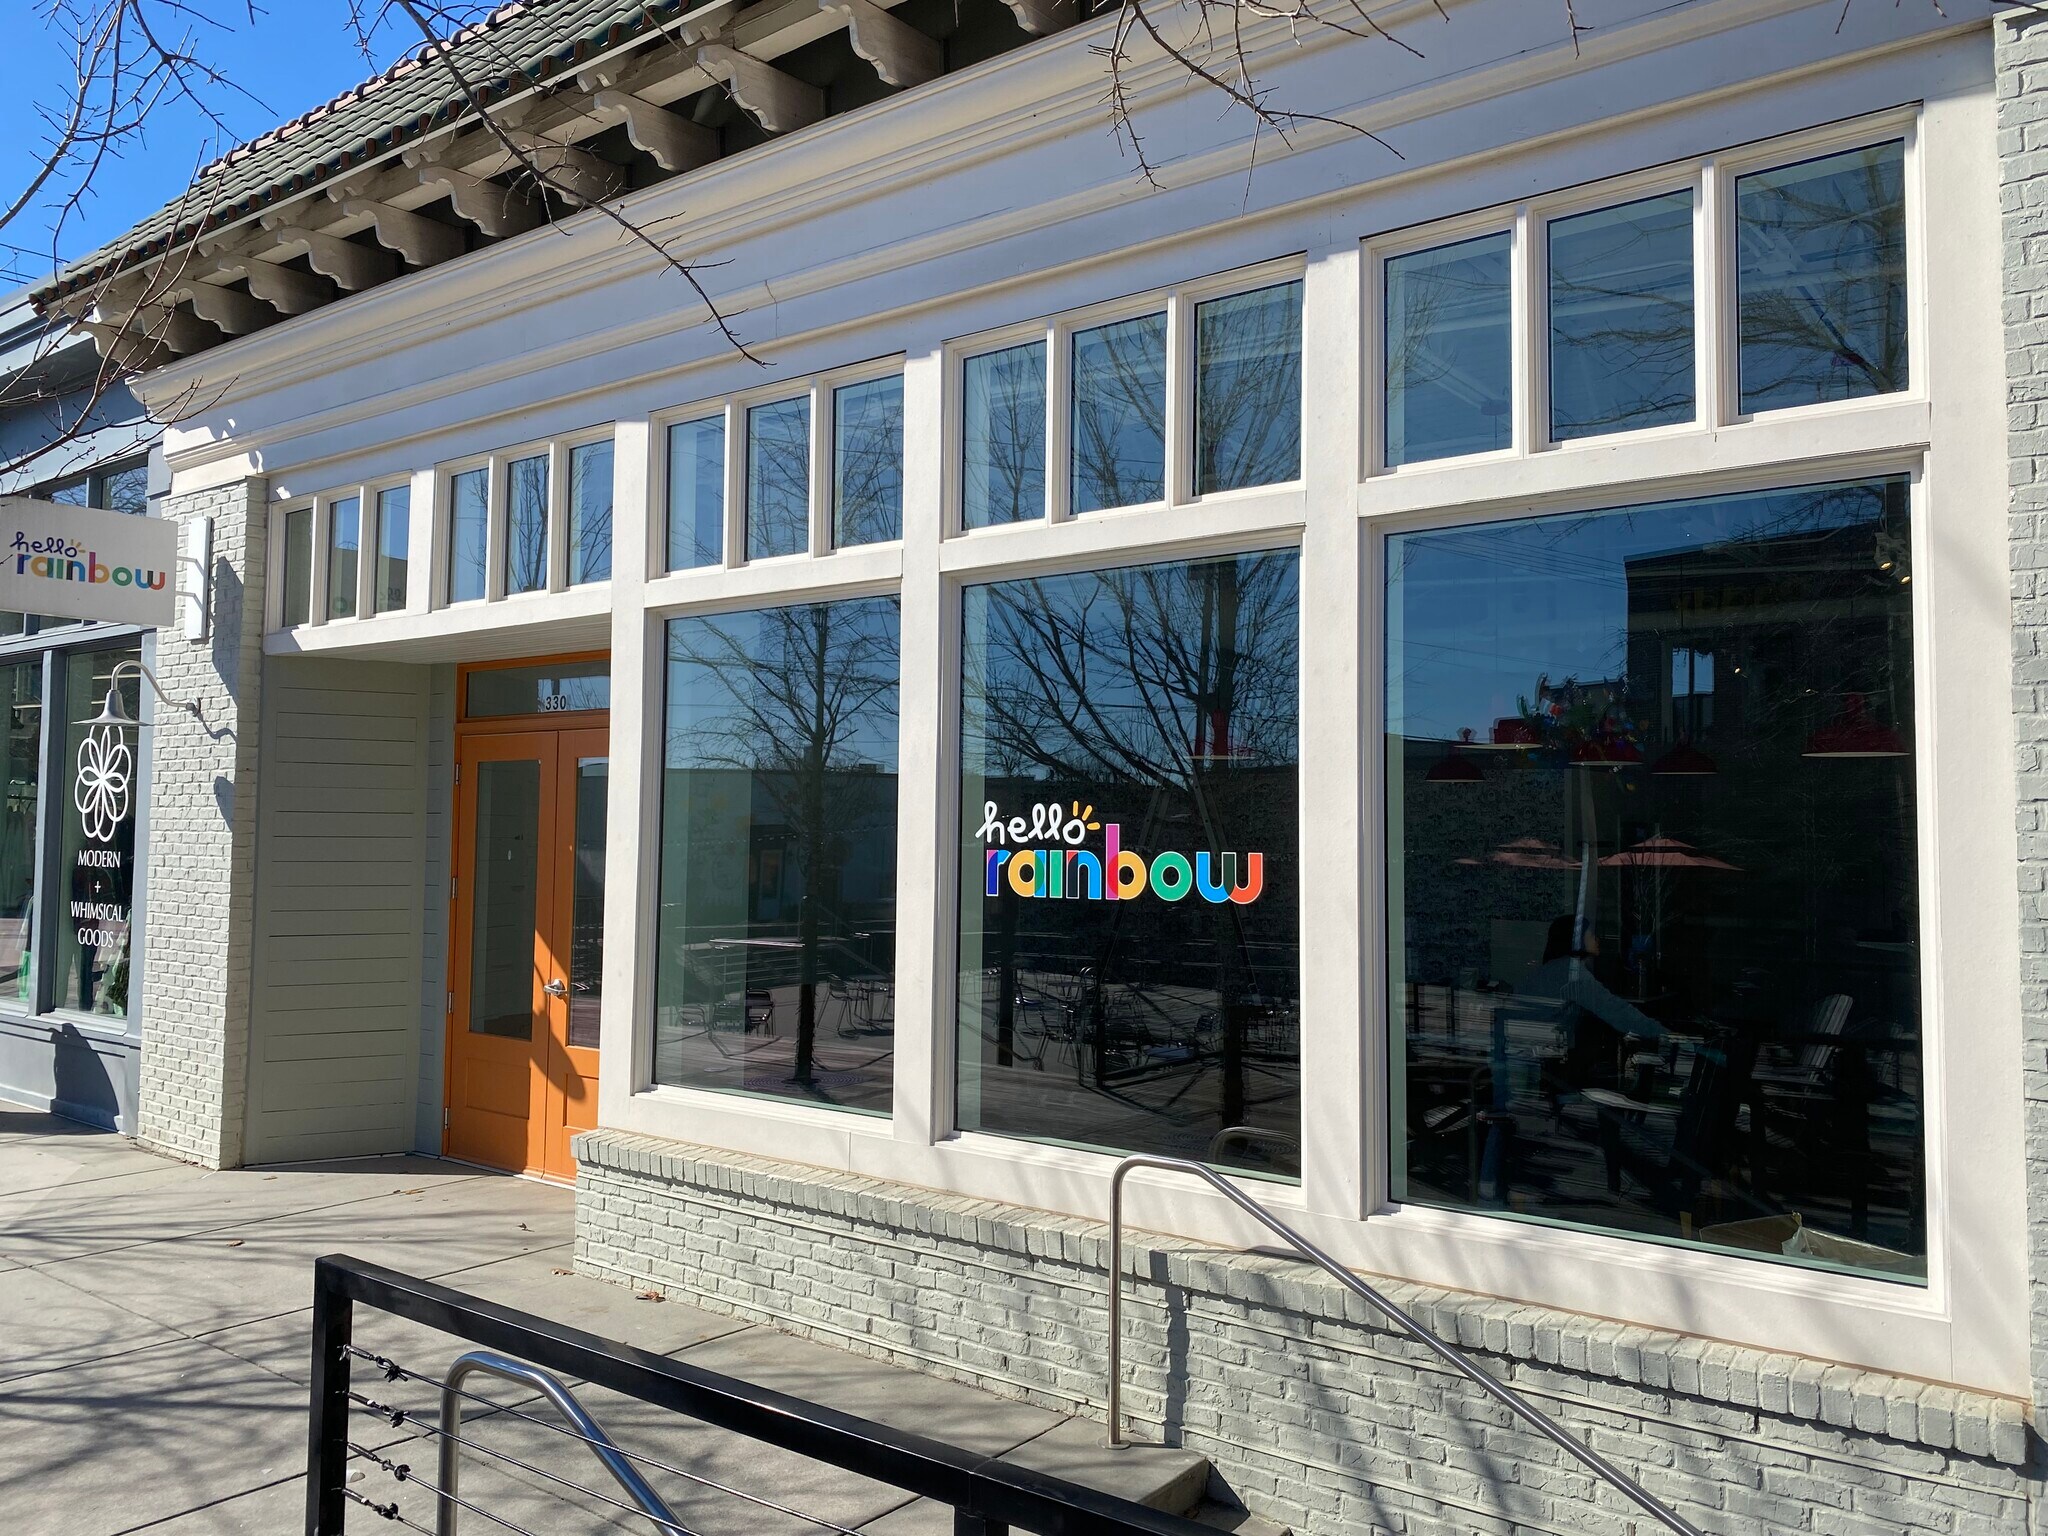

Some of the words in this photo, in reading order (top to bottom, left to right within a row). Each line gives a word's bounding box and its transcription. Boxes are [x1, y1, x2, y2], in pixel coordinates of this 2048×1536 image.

[10, 532, 77, 557] hello
[17, 552, 165, 590] rainbow
[545, 695, 567, 710] 330
[975, 801, 1085, 844] hello
[78, 850, 120, 868] MODERN
[986, 824, 1263, 904] rainbow
[71, 901, 123, 922] WHIMSICAL
[78, 928, 114, 948] GOODS
